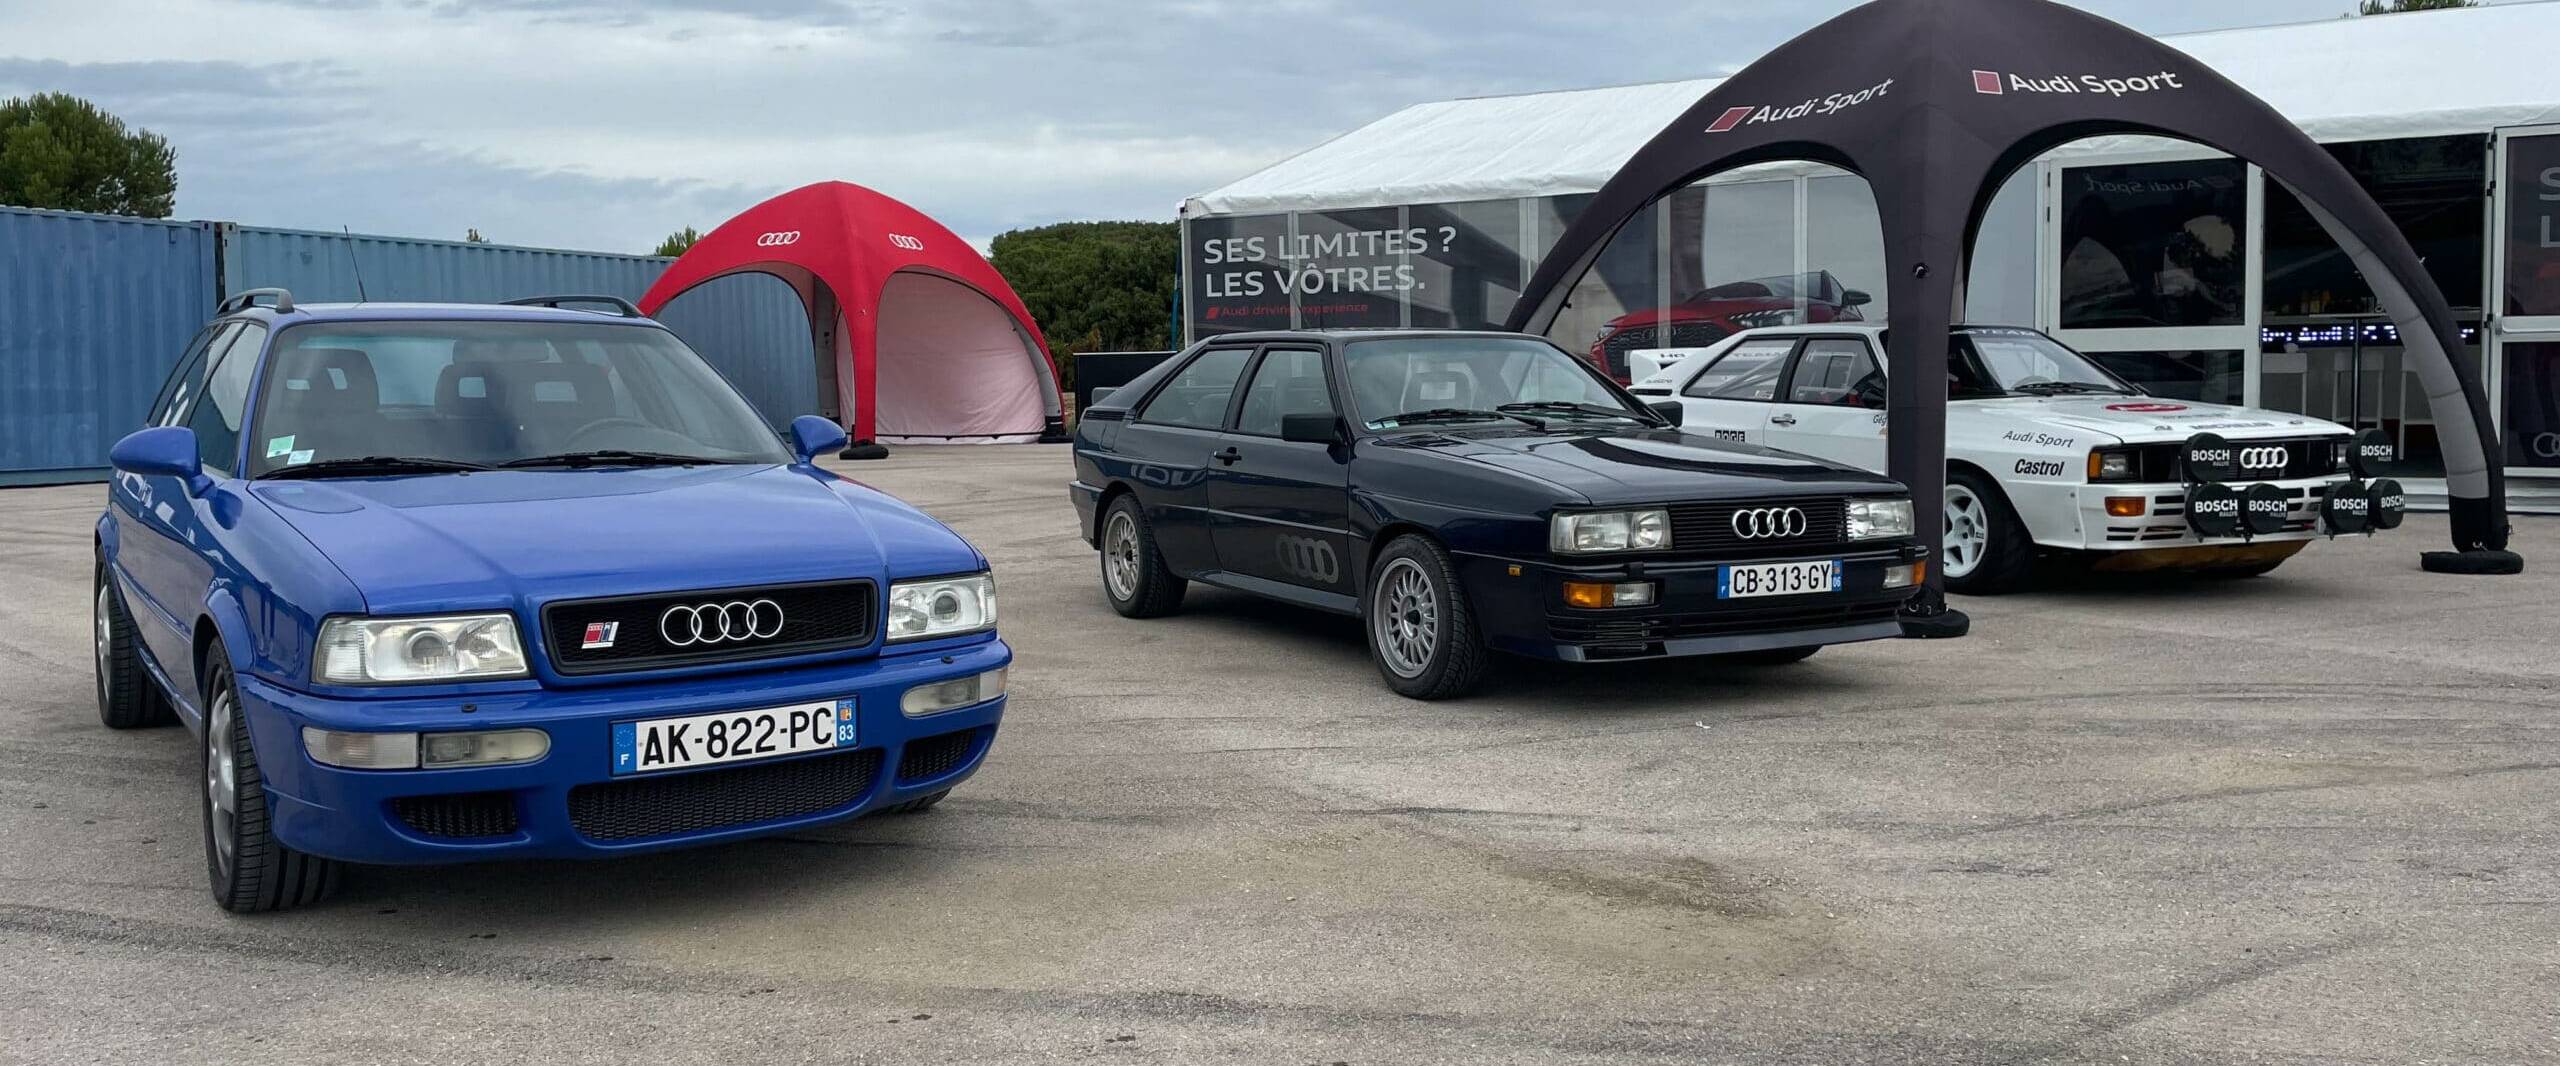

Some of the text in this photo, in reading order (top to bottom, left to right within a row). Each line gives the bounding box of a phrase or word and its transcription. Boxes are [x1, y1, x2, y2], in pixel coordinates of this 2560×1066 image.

[2008, 70, 2184, 97] Audi Sport
[1747, 77, 1894, 125] Audi Sport
[1203, 226, 1457, 264] SES LIMITES ?
[1205, 262, 1426, 298] LES VÔTRES.
[1221, 307, 1249, 318] Audi
[2003, 430, 2074, 448] Audi Sport
[2190, 449, 2231, 462] BOSCH
[2360, 445, 2393, 457] BOSCH
[2014, 458, 2065, 477] Castrol
[2194, 499, 2239, 514] BOSCH
[2248, 500, 2288, 512] BOSCH
[2333, 498, 2369, 511] BOSCH
[2380, 495, 2405, 508] BOSCH
[1733, 564, 1831, 594] CB-313-GY
[642, 707, 833, 766] AK-822-PC
[838, 724, 854, 741] 83
[620, 753, 630, 766] F
